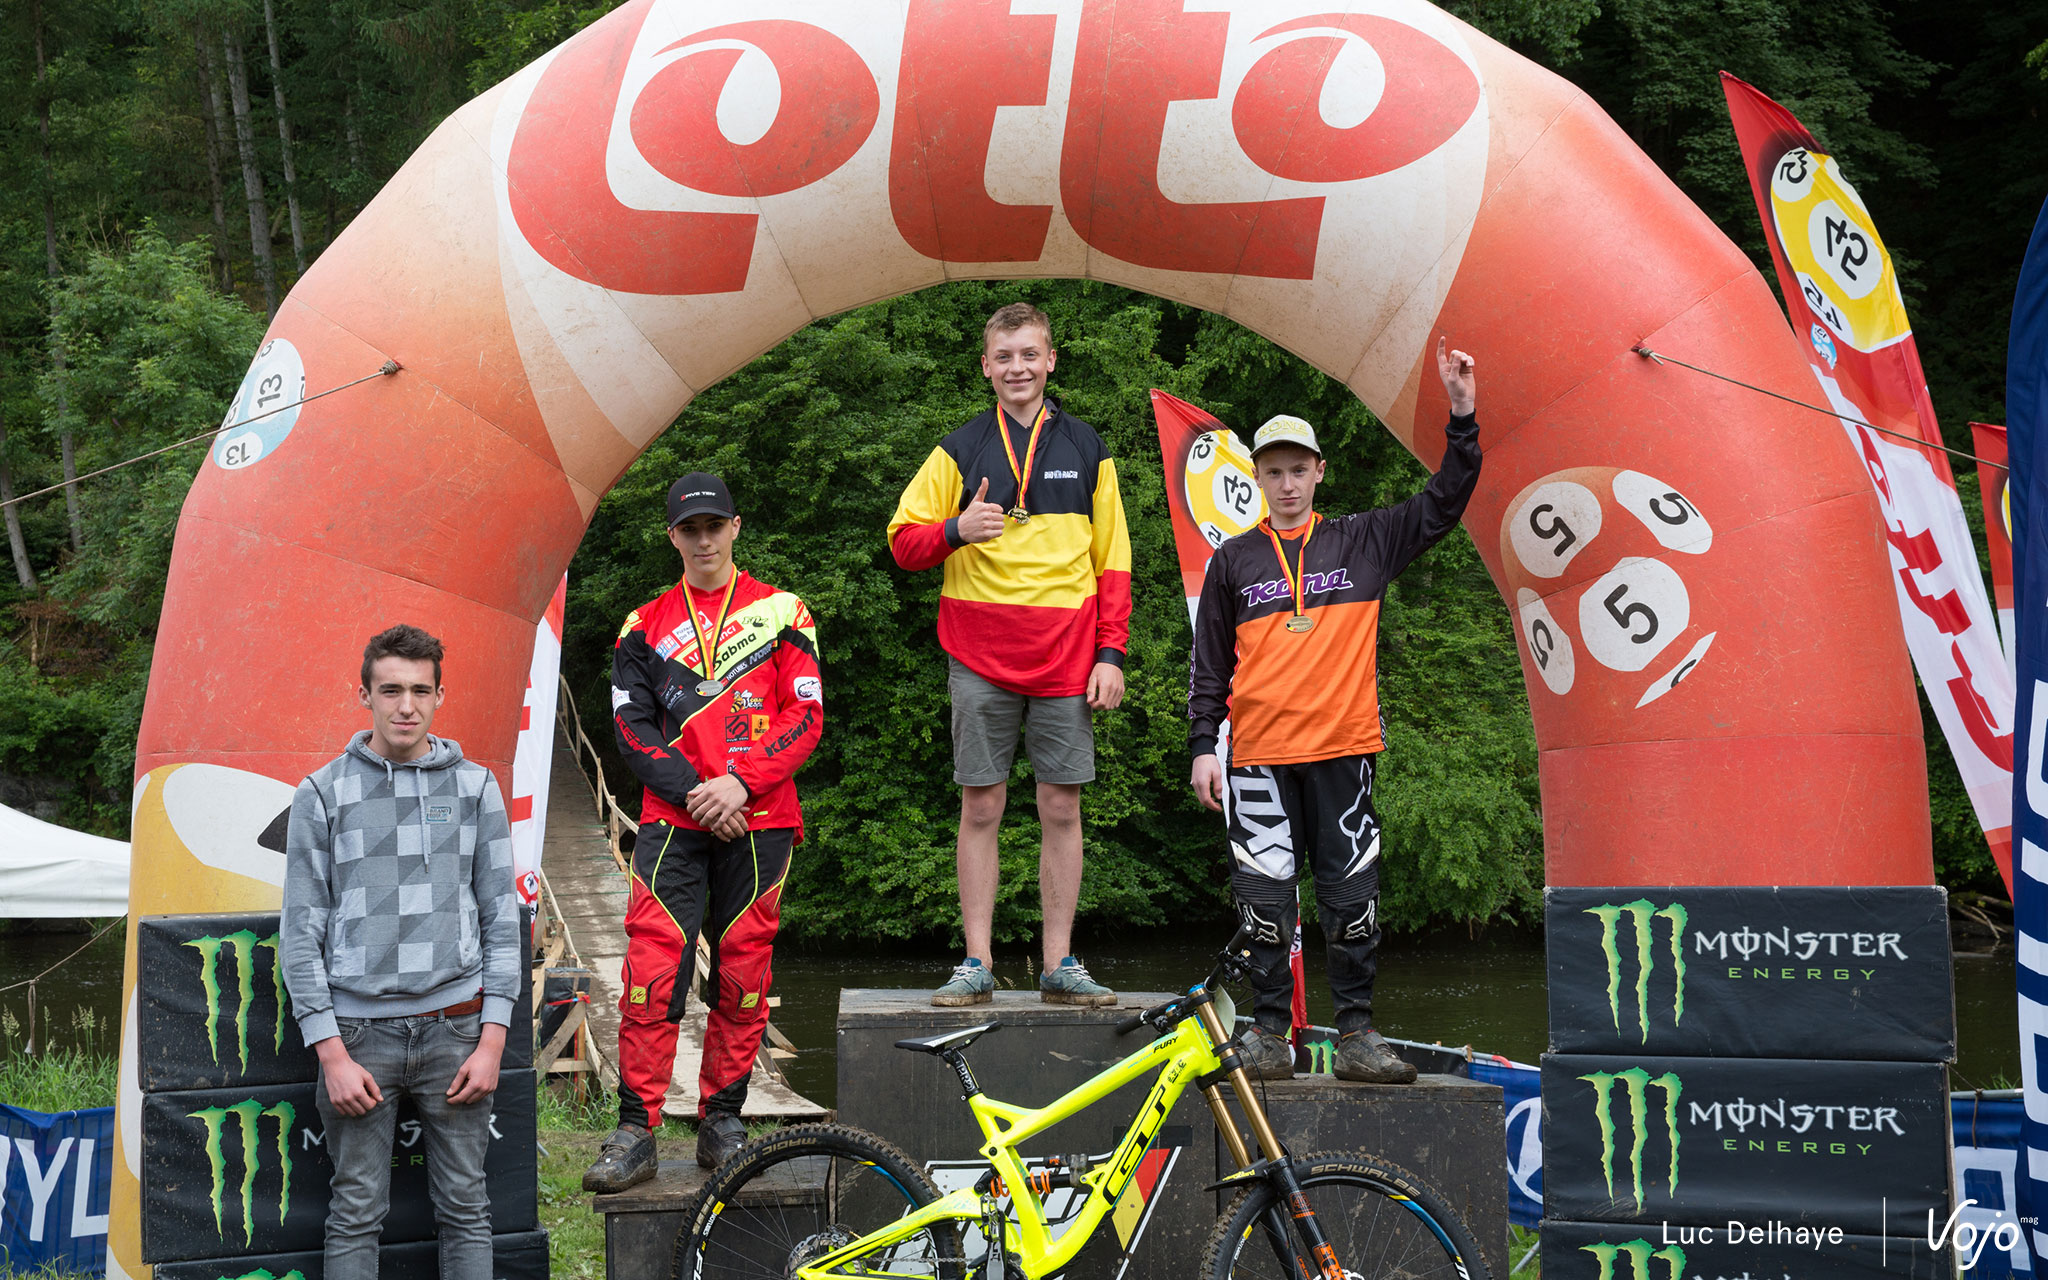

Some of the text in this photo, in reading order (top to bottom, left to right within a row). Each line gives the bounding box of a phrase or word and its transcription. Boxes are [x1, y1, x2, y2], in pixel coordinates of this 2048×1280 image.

[1825, 216, 1868, 281] 42
[257, 374, 282, 408] 13
[226, 442, 251, 466] 13
[1224, 475, 1252, 515] 42
[1649, 492, 1699, 525] 5
[1530, 504, 1577, 557] 5
[1603, 584, 1659, 644] 5
[1694, 926, 1908, 961] MONSTER
[1728, 967, 1876, 980] ENERGY
[1153, 1036, 1178, 1053] FURY
[1688, 1097, 1905, 1136] MONSTER
[1723, 1139, 1872, 1155] ENERGY
[718, 1137, 817, 1193] MAGIC MARY
[1310, 1163, 1421, 1198] SCHWALBE
